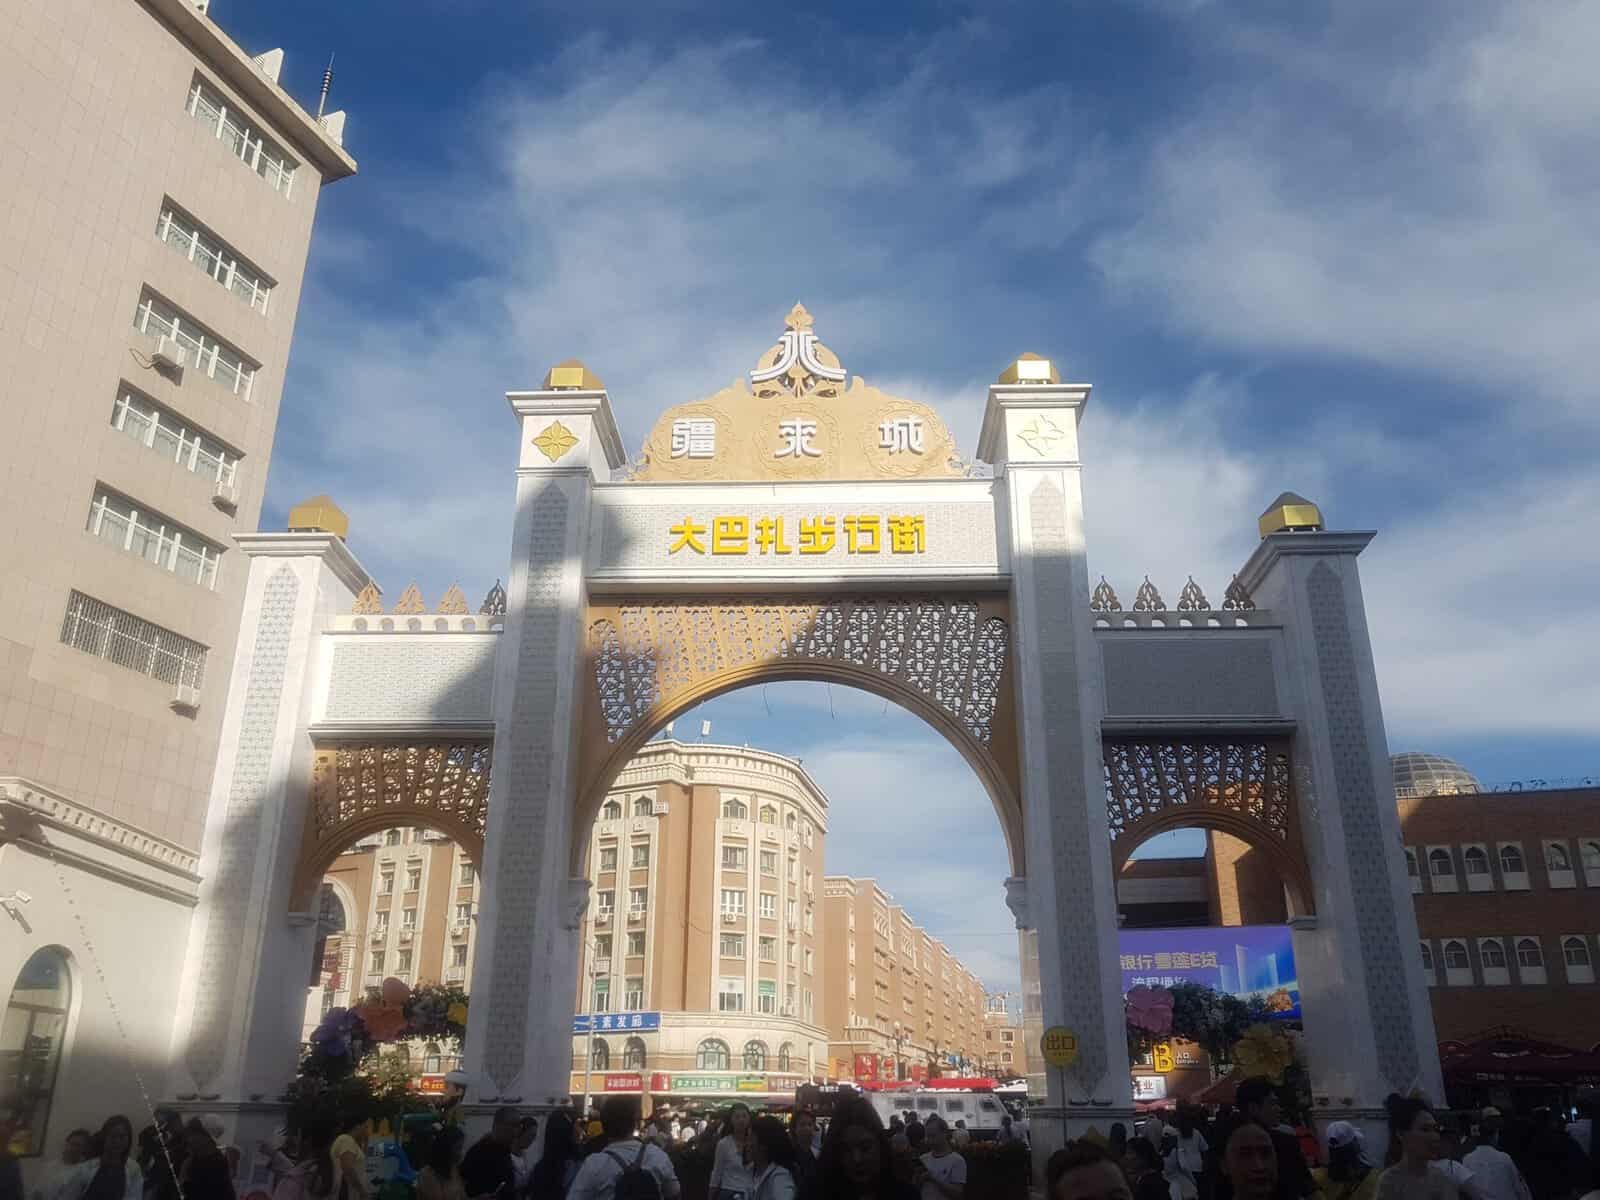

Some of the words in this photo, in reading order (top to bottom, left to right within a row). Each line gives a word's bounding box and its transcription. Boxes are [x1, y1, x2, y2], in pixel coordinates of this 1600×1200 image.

[669, 514, 926, 555] 大巴扎步行街
[1047, 1035, 1075, 1051] 出口
[1153, 1044, 1175, 1073] B
